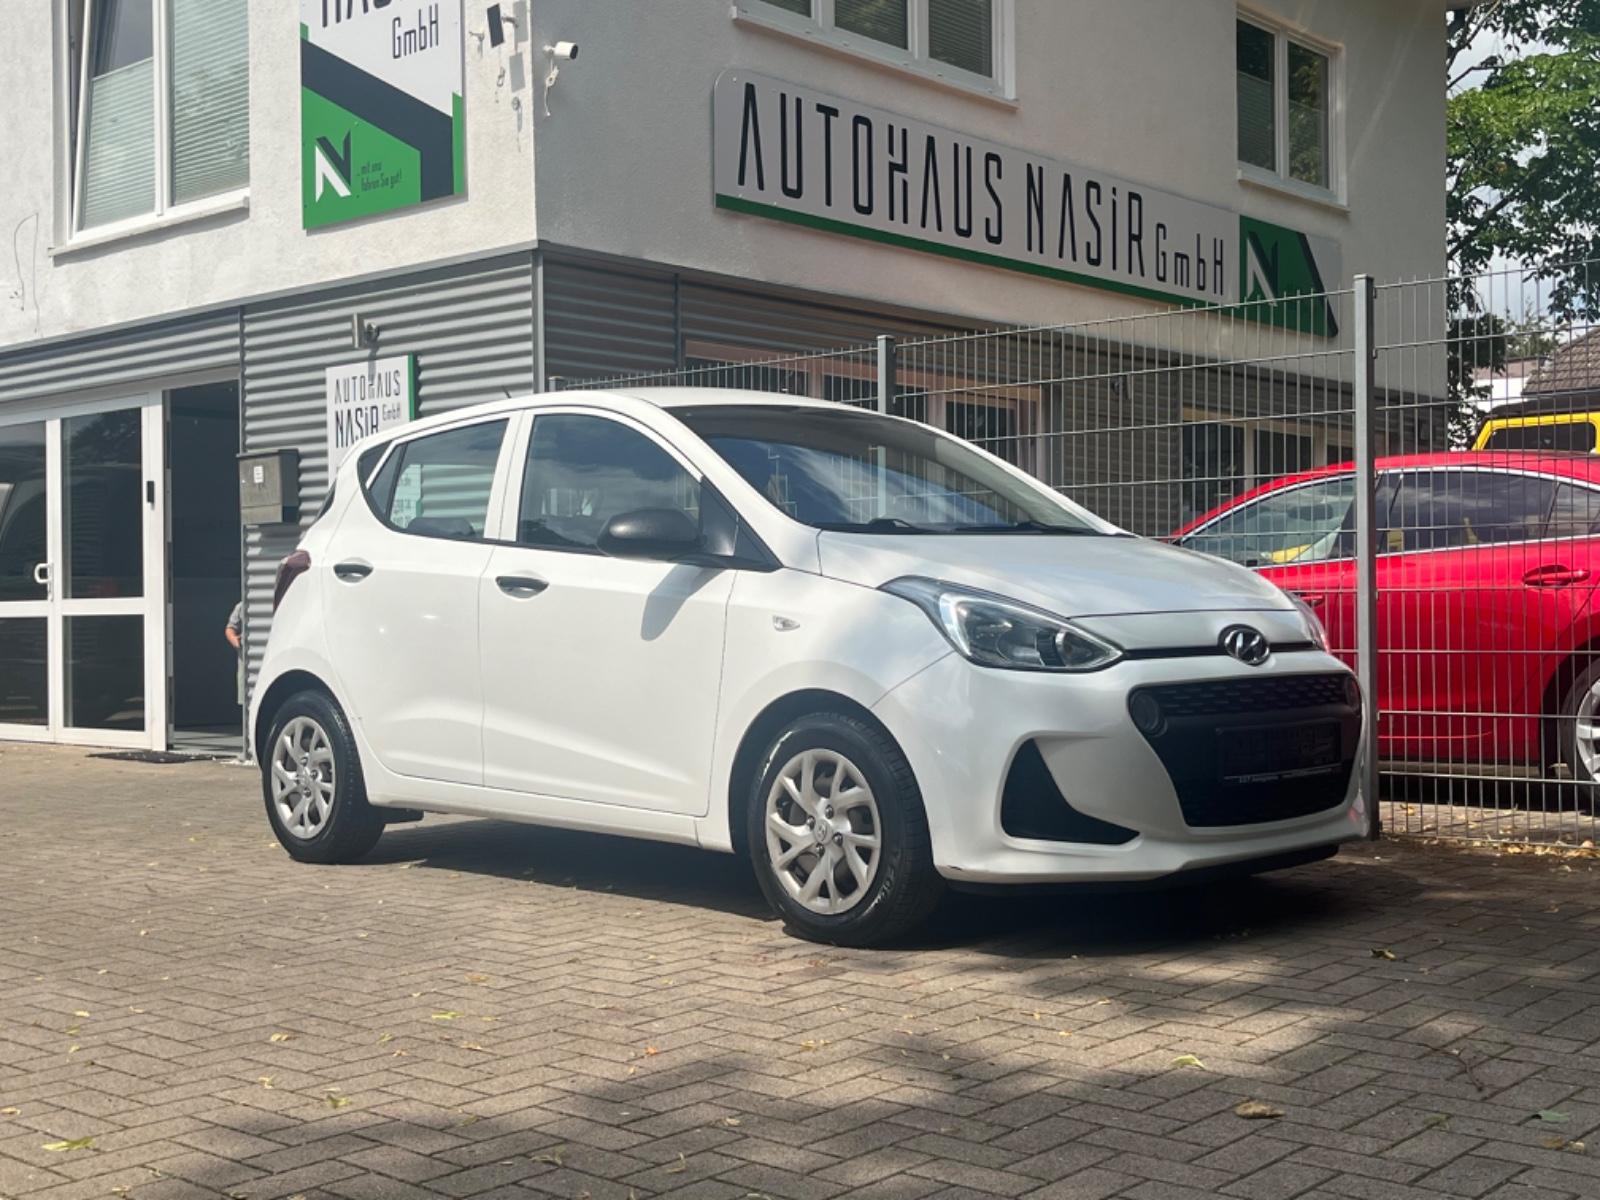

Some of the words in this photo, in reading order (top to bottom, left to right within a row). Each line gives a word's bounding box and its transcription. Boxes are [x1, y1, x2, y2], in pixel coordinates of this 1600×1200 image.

[392, 3, 439, 59] GmbH
[738, 82, 1003, 245] AUTOHAUS
[1156, 223, 1225, 296] GmbH
